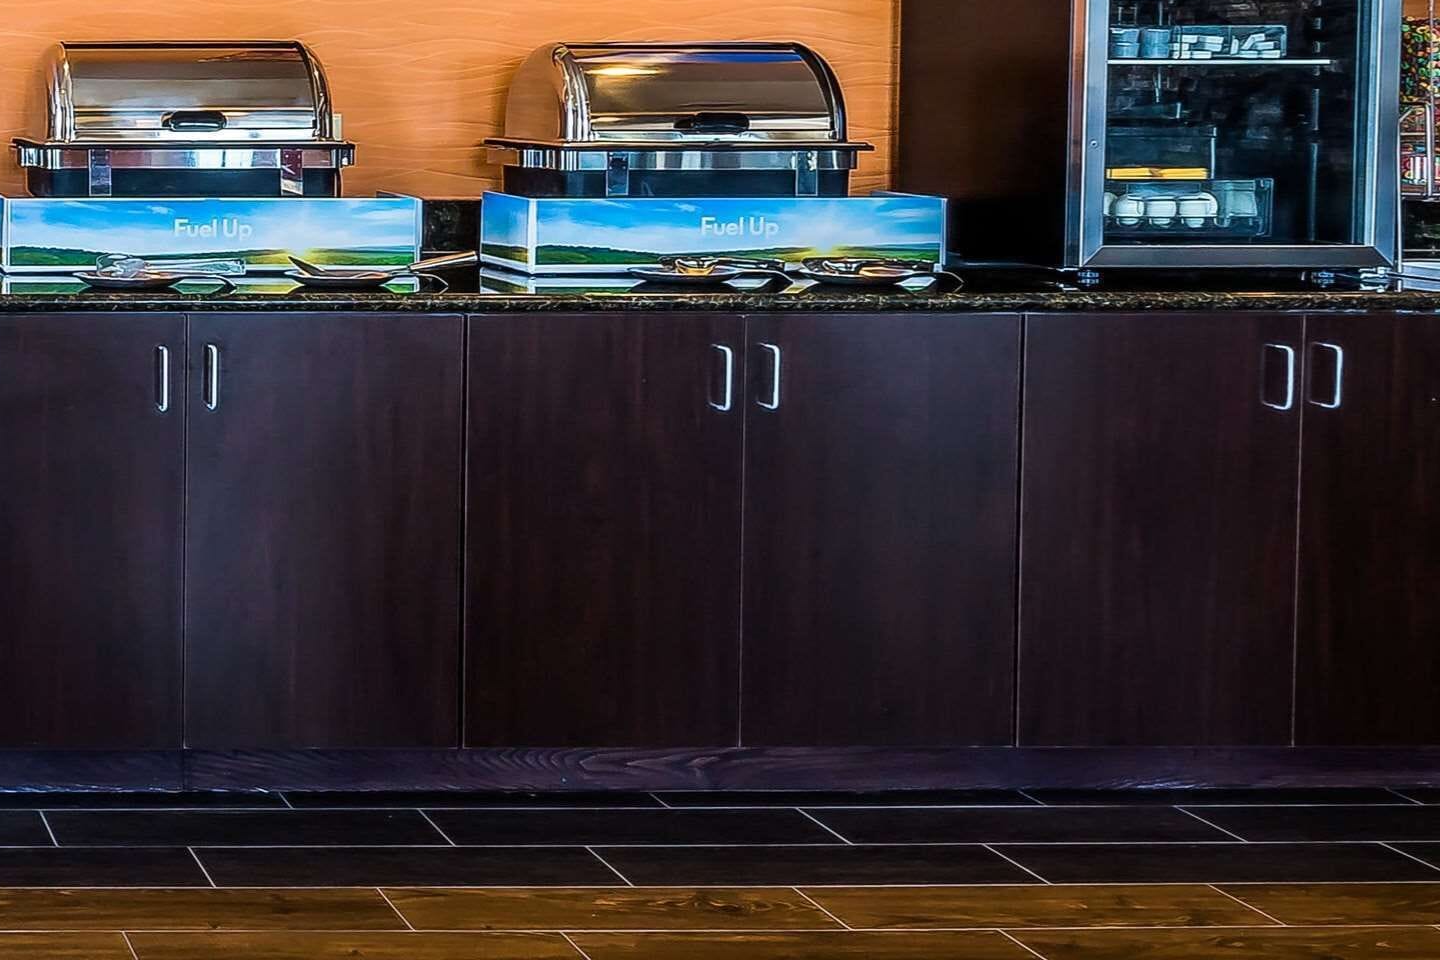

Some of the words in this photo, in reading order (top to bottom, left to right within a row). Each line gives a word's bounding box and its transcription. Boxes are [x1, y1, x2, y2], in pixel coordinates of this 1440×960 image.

[174, 219, 217, 238] Fuel
[223, 219, 252, 241] Up
[701, 217, 744, 236] Fuel
[750, 217, 779, 240] Up
